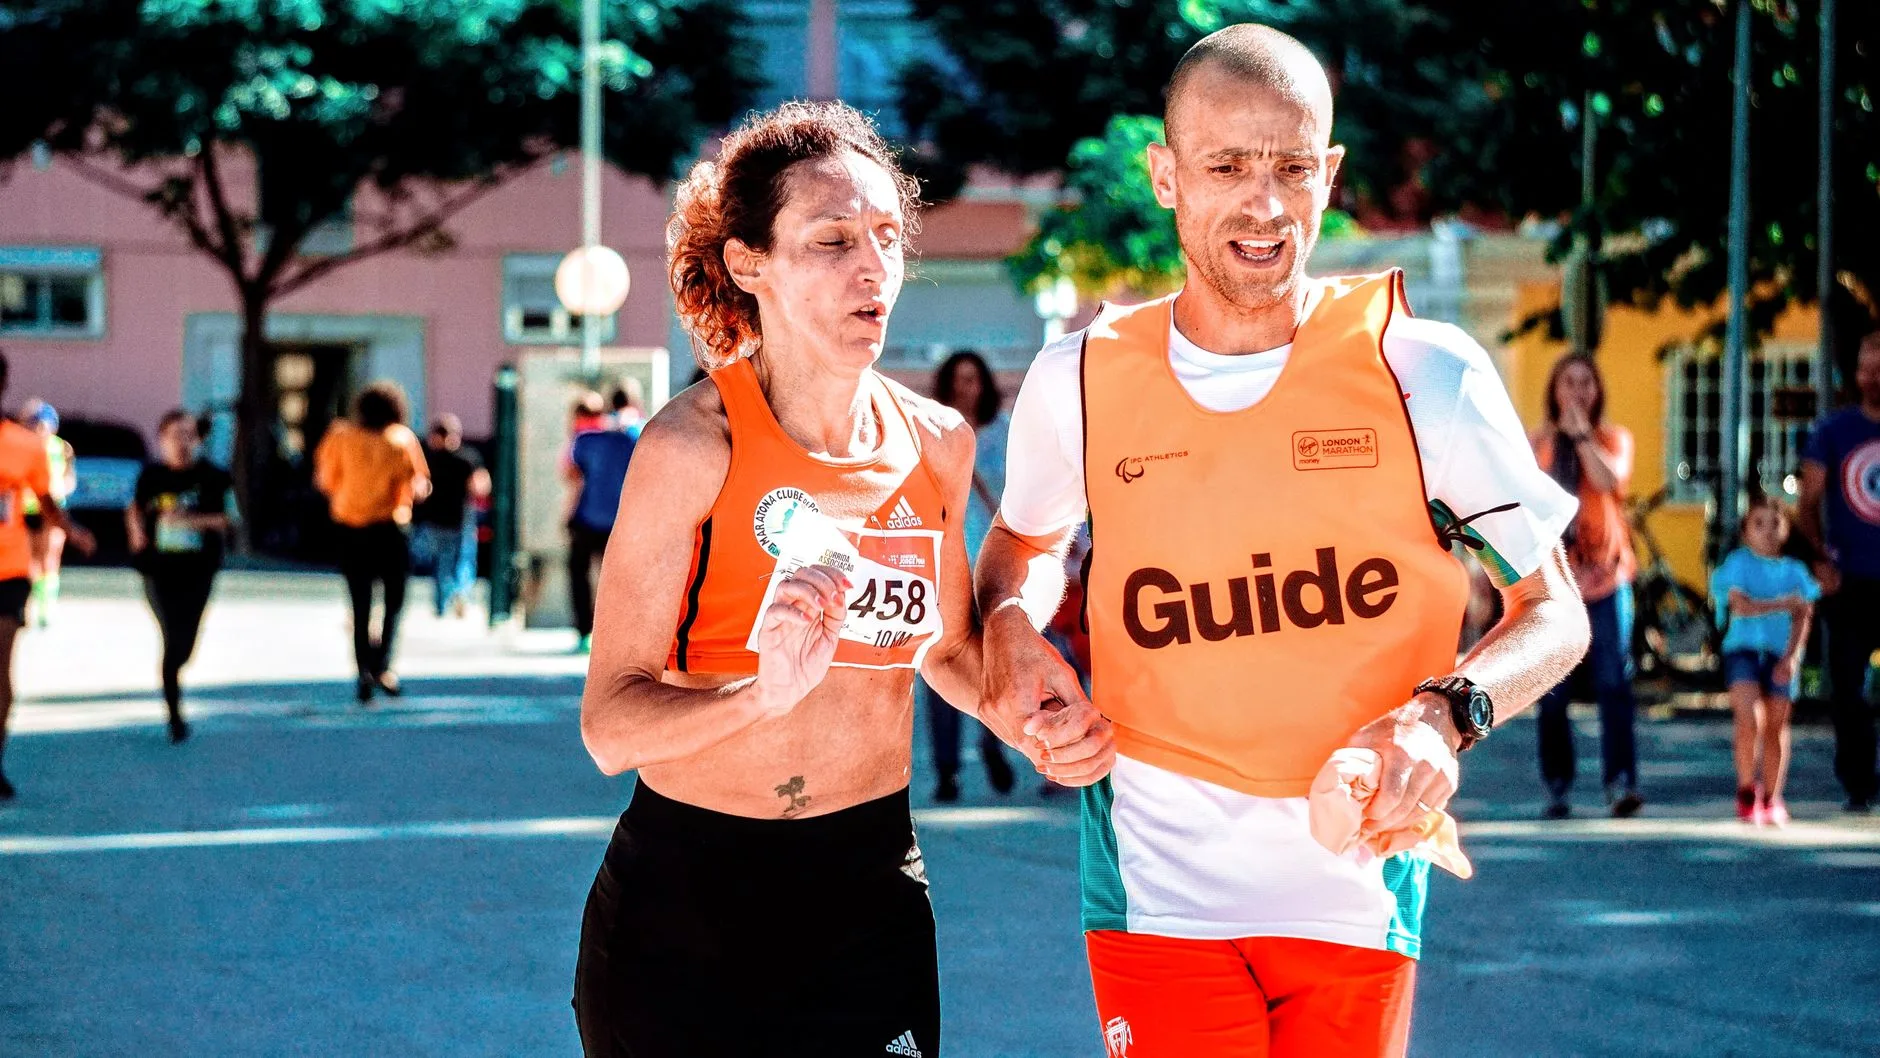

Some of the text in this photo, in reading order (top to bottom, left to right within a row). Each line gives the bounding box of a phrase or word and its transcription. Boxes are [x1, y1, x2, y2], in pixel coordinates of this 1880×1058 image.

[1322, 438, 1360, 446] LONDON
[1145, 450, 1189, 462] ATHLETICS
[1322, 446, 1373, 455] MARATHON
[755, 494, 777, 546] MARATONA
[776, 489, 804, 502] CLUBE
[887, 516, 922, 529] adidas
[825, 549, 850, 562] CORRIDA
[848, 578, 926, 625] 458
[1123, 546, 1399, 649] Guide
[885, 1044, 922, 1058] adidas
